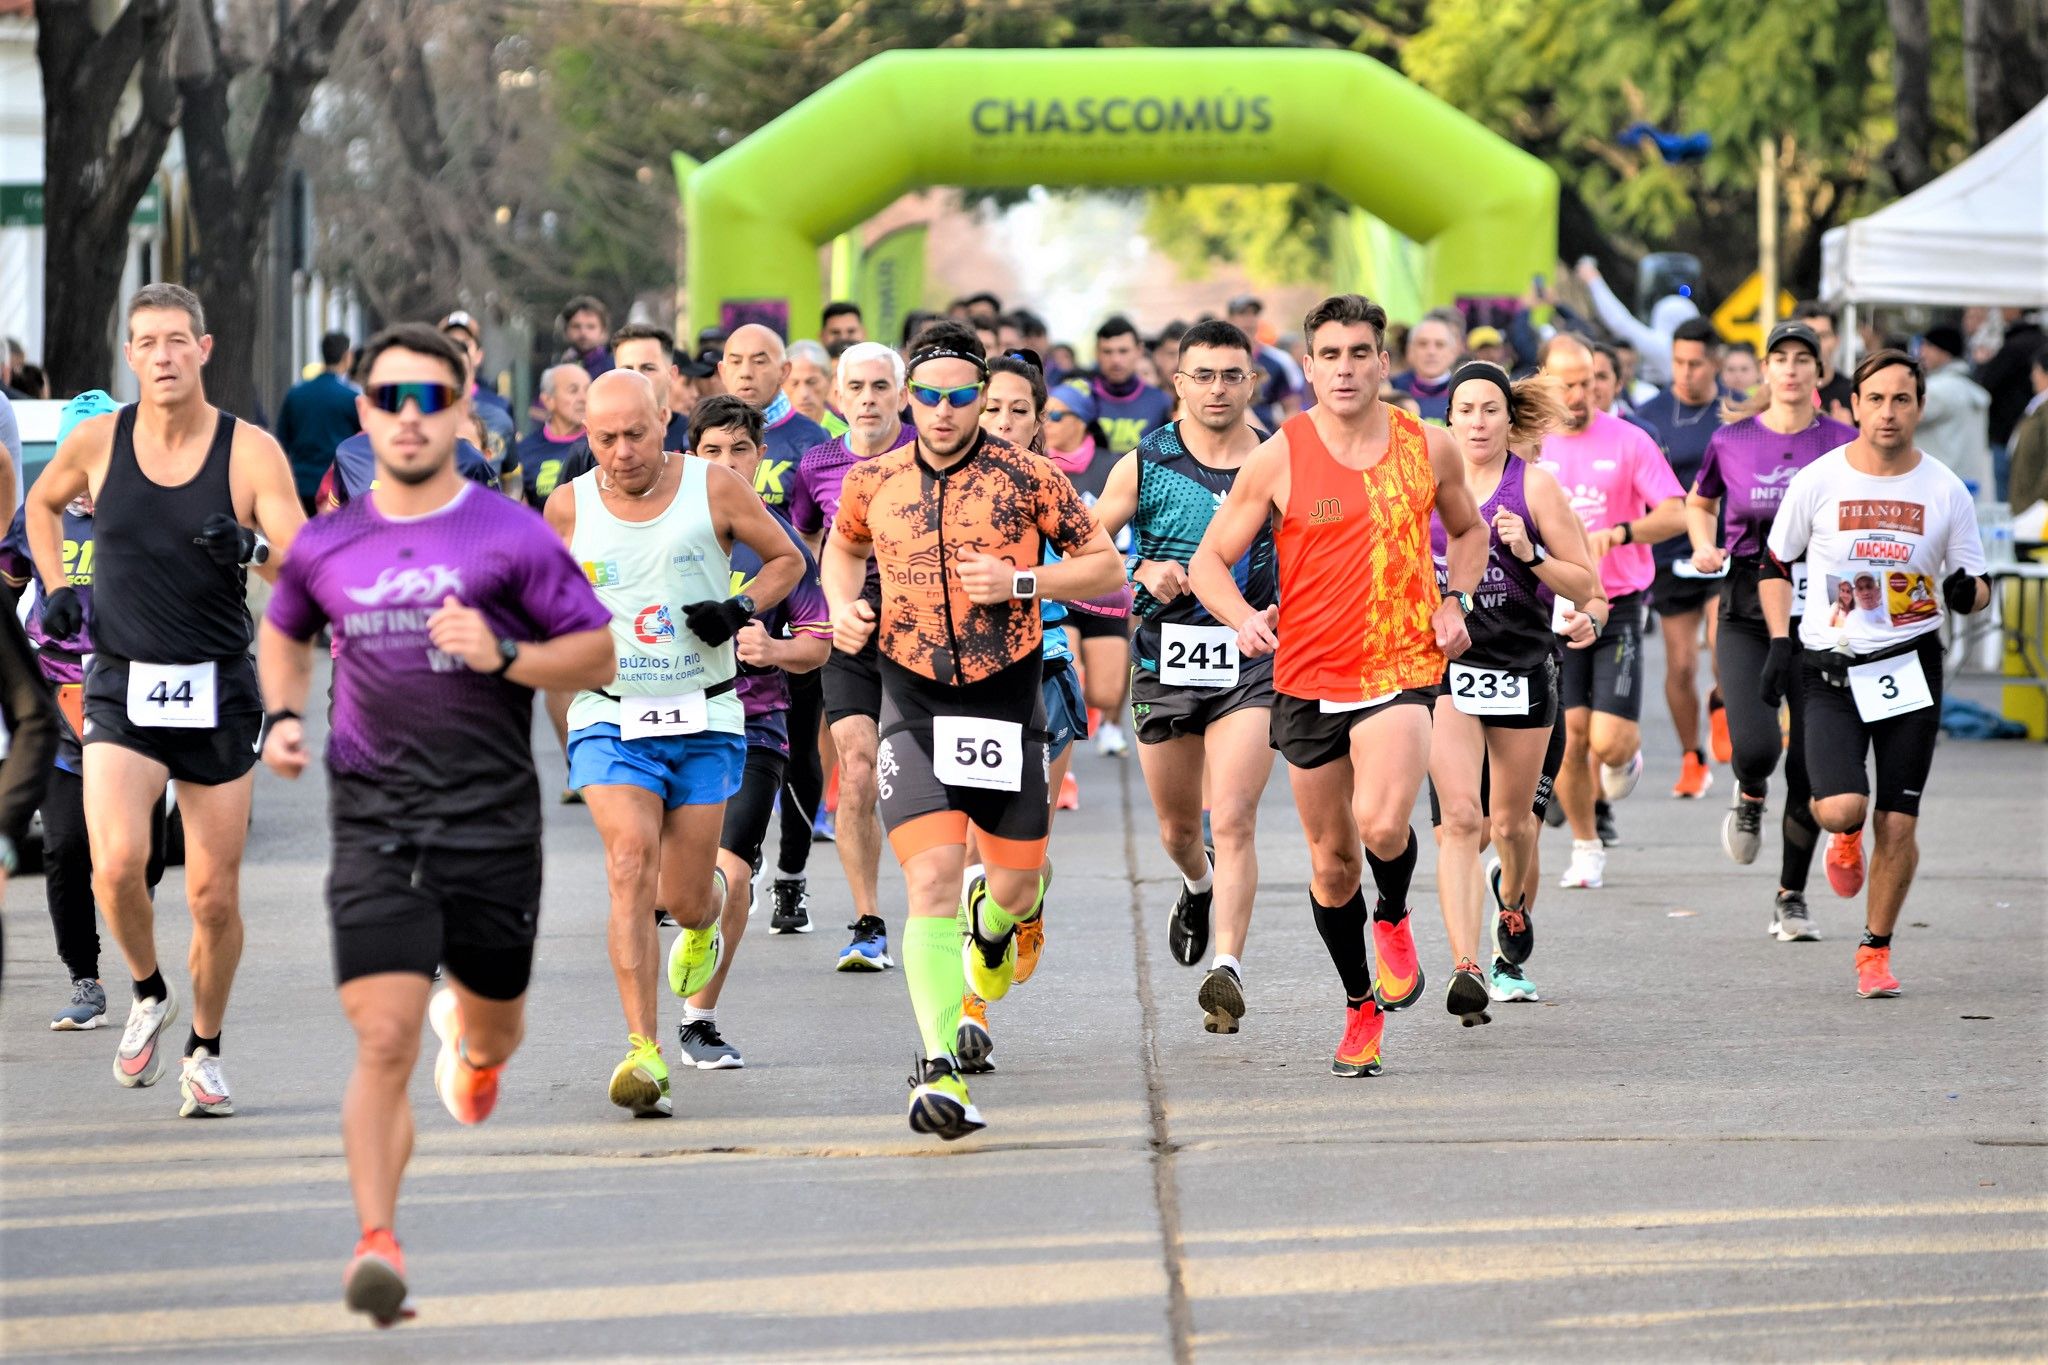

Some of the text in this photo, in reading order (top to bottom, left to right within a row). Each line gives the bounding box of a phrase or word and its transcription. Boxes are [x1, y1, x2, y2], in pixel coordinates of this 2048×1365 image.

[970, 88, 1273, 134] CHASCOMÚS
[1857, 542, 1909, 561] MACHADO
[1480, 593, 1508, 609] WF
[619, 654, 670, 669] BÚZIOS
[684, 652, 701, 666] RIO
[1166, 641, 1234, 670] 241
[617, 666, 705, 681] TALENTOS EM CORRIDA
[1456, 672, 1521, 699] 233
[146, 680, 194, 708] 44
[1878, 674, 1899, 700] 3
[639, 709, 689, 724] 41
[955, 737, 1003, 769] 56
